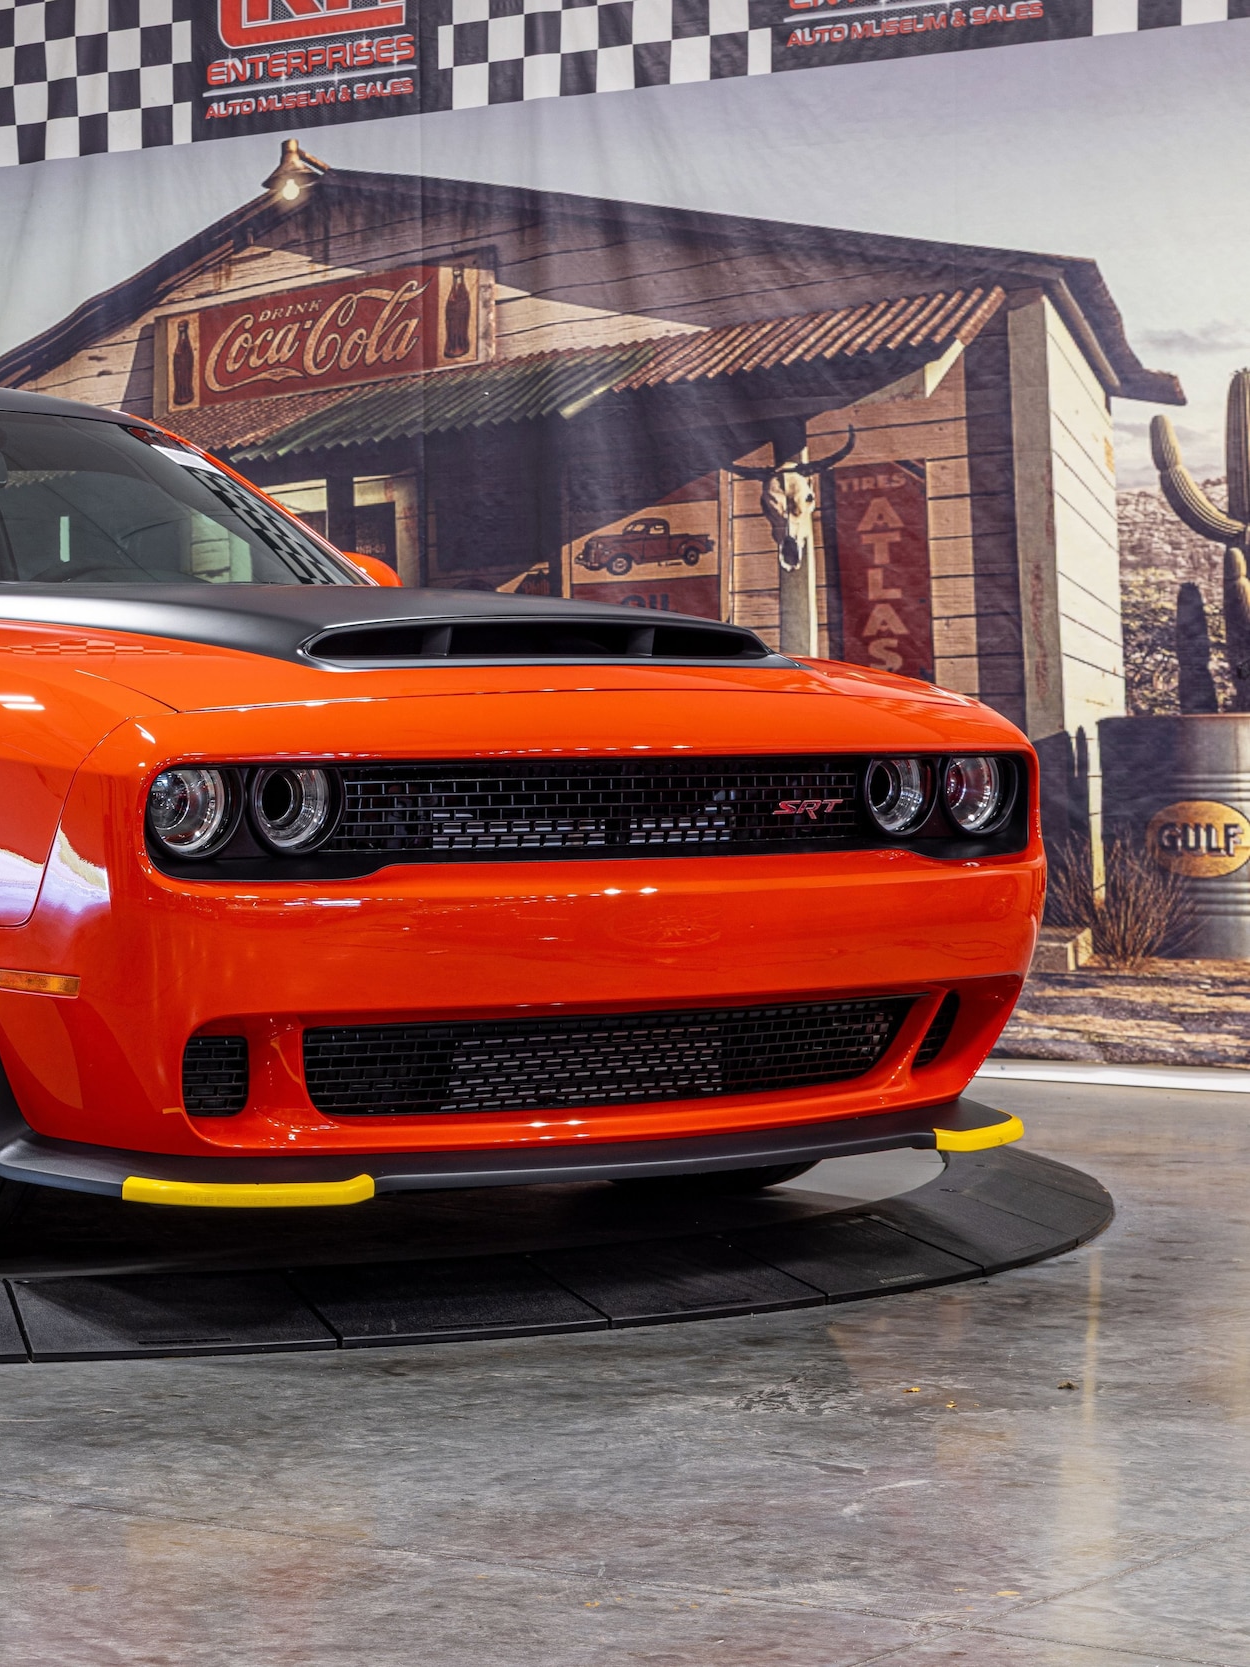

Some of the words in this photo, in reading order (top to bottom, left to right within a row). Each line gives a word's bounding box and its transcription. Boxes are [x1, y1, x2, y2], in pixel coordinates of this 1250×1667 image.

[786, 22, 848, 48] AUTO
[850, 11, 947, 40] MUSEUM
[950, 7, 966, 28] &
[970, 0, 1044, 26] SALES
[206, 34, 415, 86] ENTERPRISES
[205, 97, 256, 120] AUTO
[257, 88, 336, 113] MUSEUM
[338, 84, 351, 102] &
[353, 77, 414, 101] SALES
[257, 298, 323, 323] DRINK
[837, 473, 907, 493] TIRES
[856, 497, 910, 673] ATLAS
[772, 799, 844, 819] SRT
[1157, 822, 1244, 857] GULF
